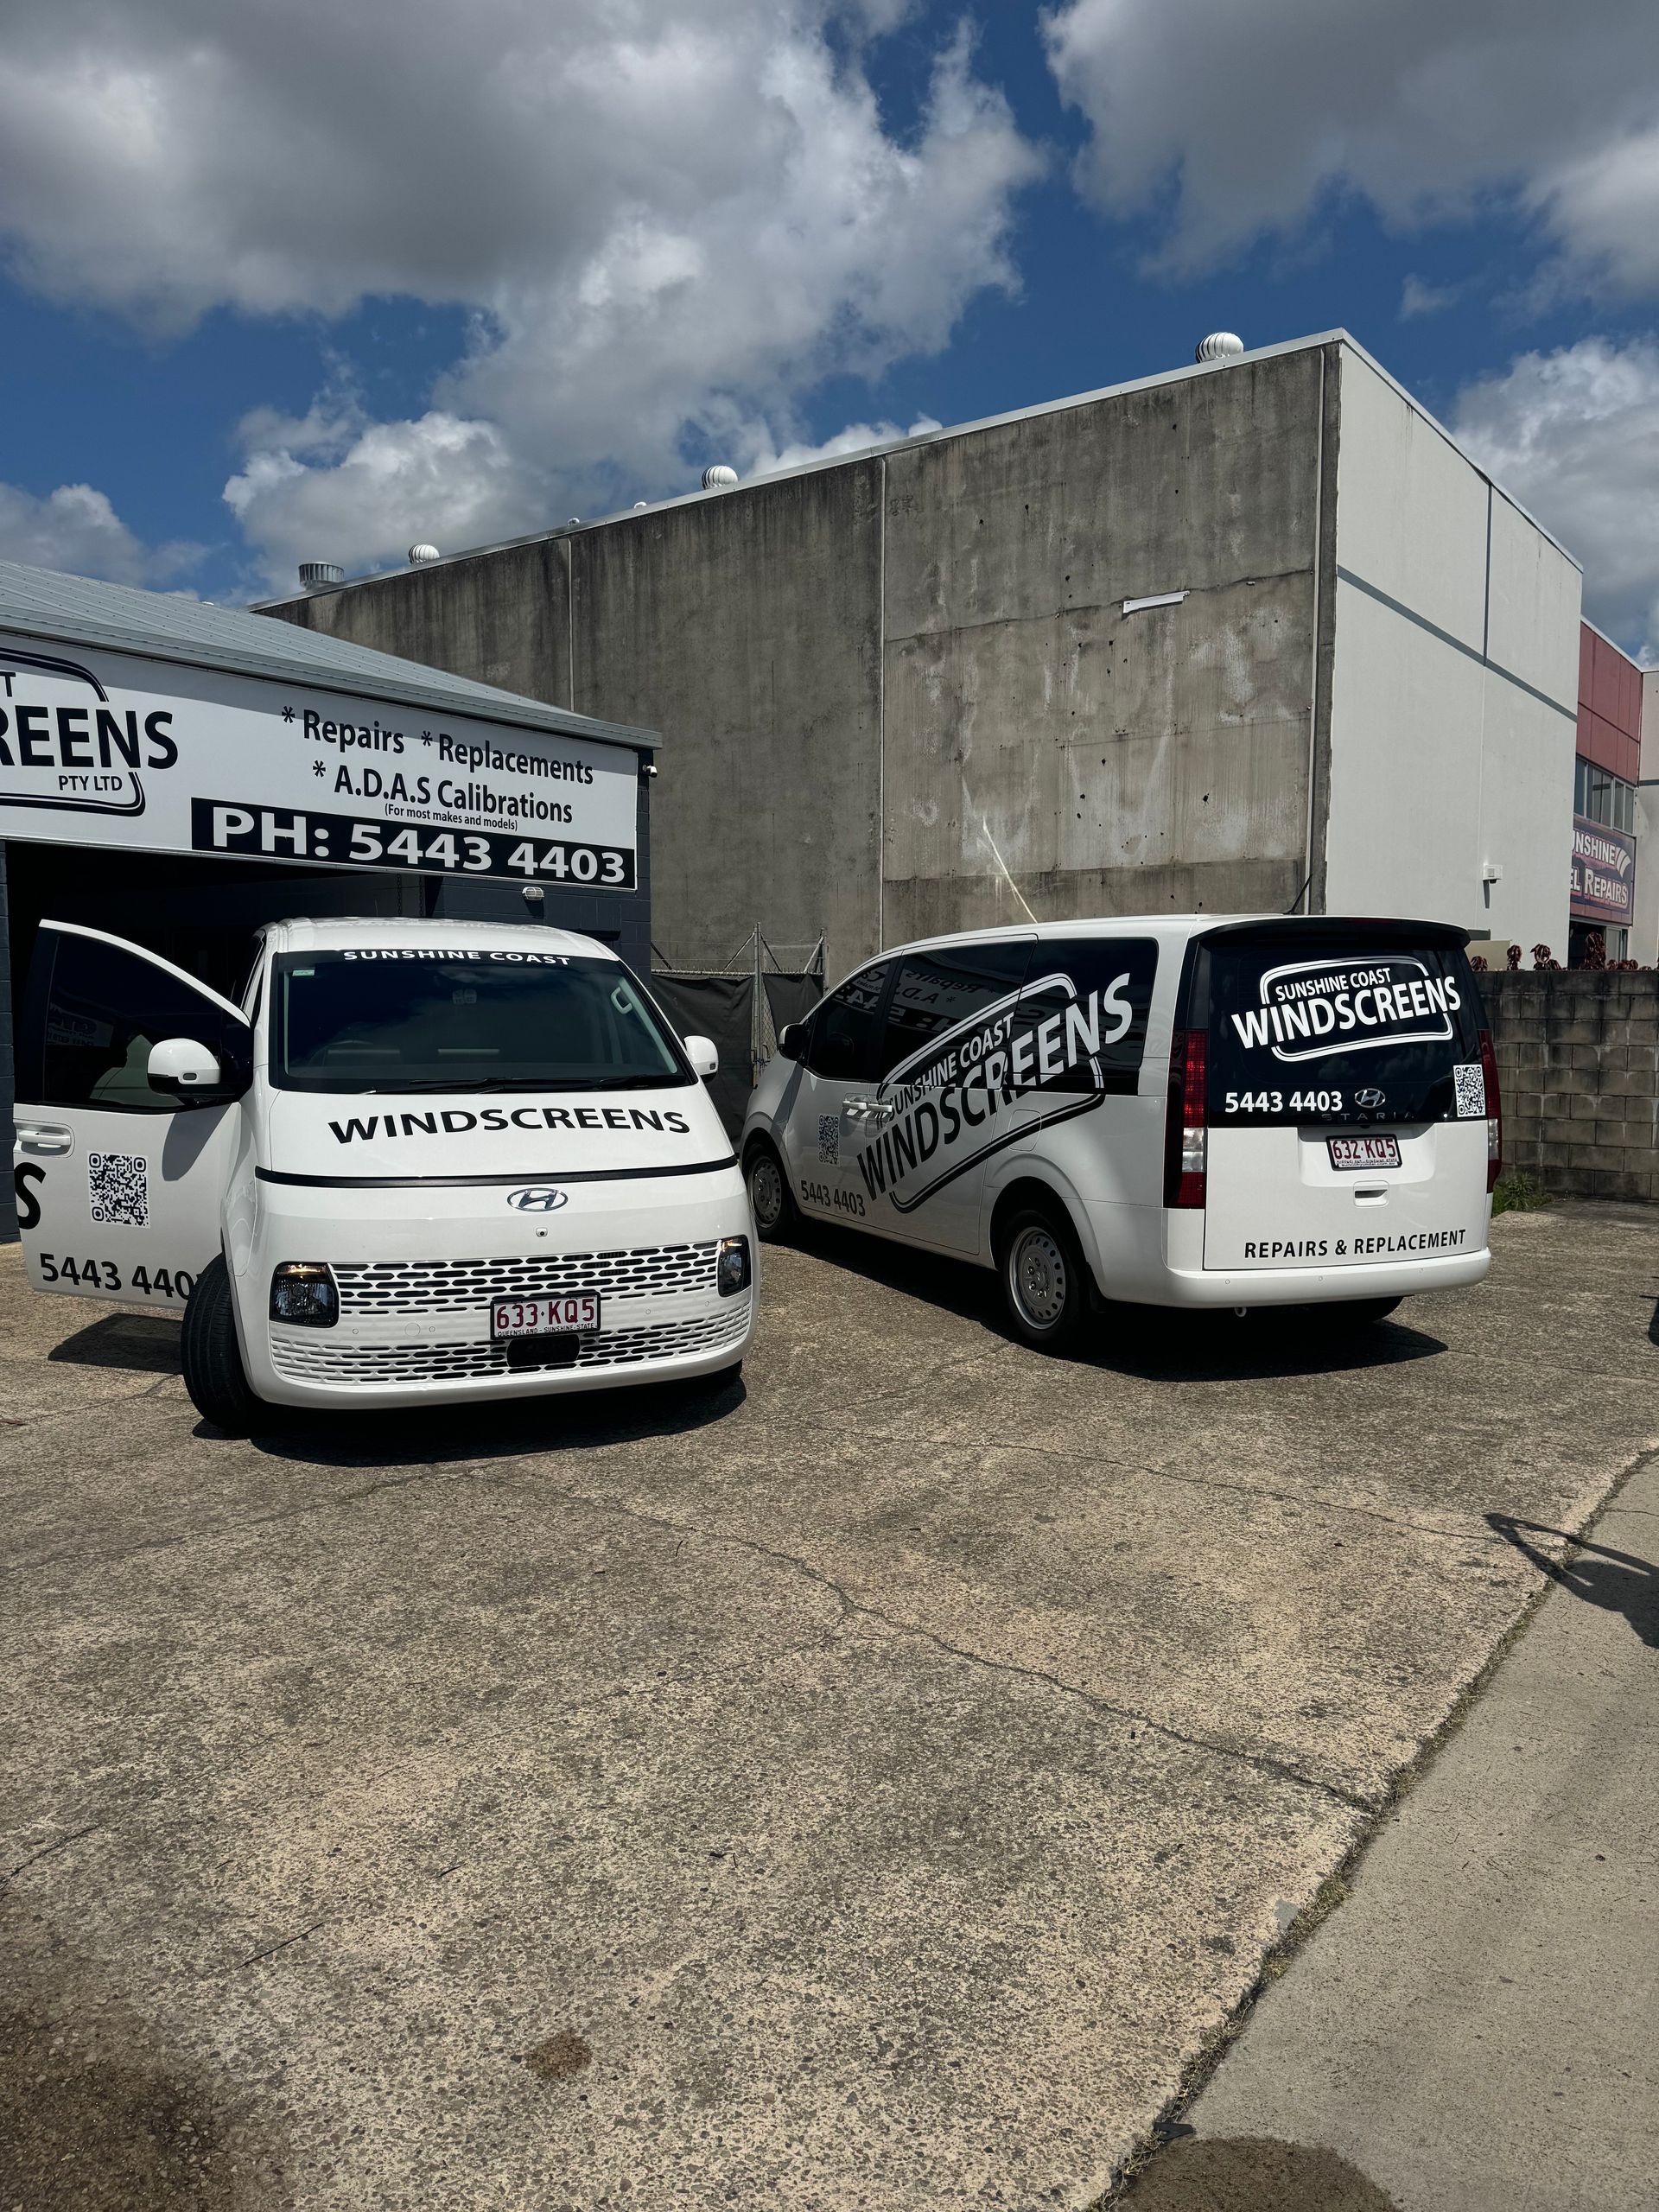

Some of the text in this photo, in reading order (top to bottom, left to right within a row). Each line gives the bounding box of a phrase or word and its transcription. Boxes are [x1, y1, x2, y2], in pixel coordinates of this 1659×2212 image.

[303, 709, 594, 785] Repairs Replacements
[58, 775, 123, 791] PTY LTD
[334, 765, 573, 823] A.D.A.S Calibrations
[385, 803, 518, 831] (For most makes and models)
[212, 806, 626, 884] PH: 5443 4403
[1571, 868, 1628, 906] L REPAIRS
[344, 950, 570, 966] SUNSHINE COAST
[1274, 967, 1391, 1002] SUNSHINE COAST
[1230, 976, 1462, 1049] WINDSCREENS
[959, 1011, 1014, 1068] COAST
[856, 972, 1134, 1202] WINDSCREENS
[1224, 1090, 1344, 1113] 5443 4403
[327, 1108, 691, 1144] WINDSCREENS
[14, 1161, 47, 1230] S
[800, 1179, 865, 1217] 5443 4403
[1244, 1229, 1466, 1258] REPAIRS & REPLACEMENT
[40, 1252, 202, 1301] 5443 440
[543, 1325, 574, 1333] SUNSHINE
